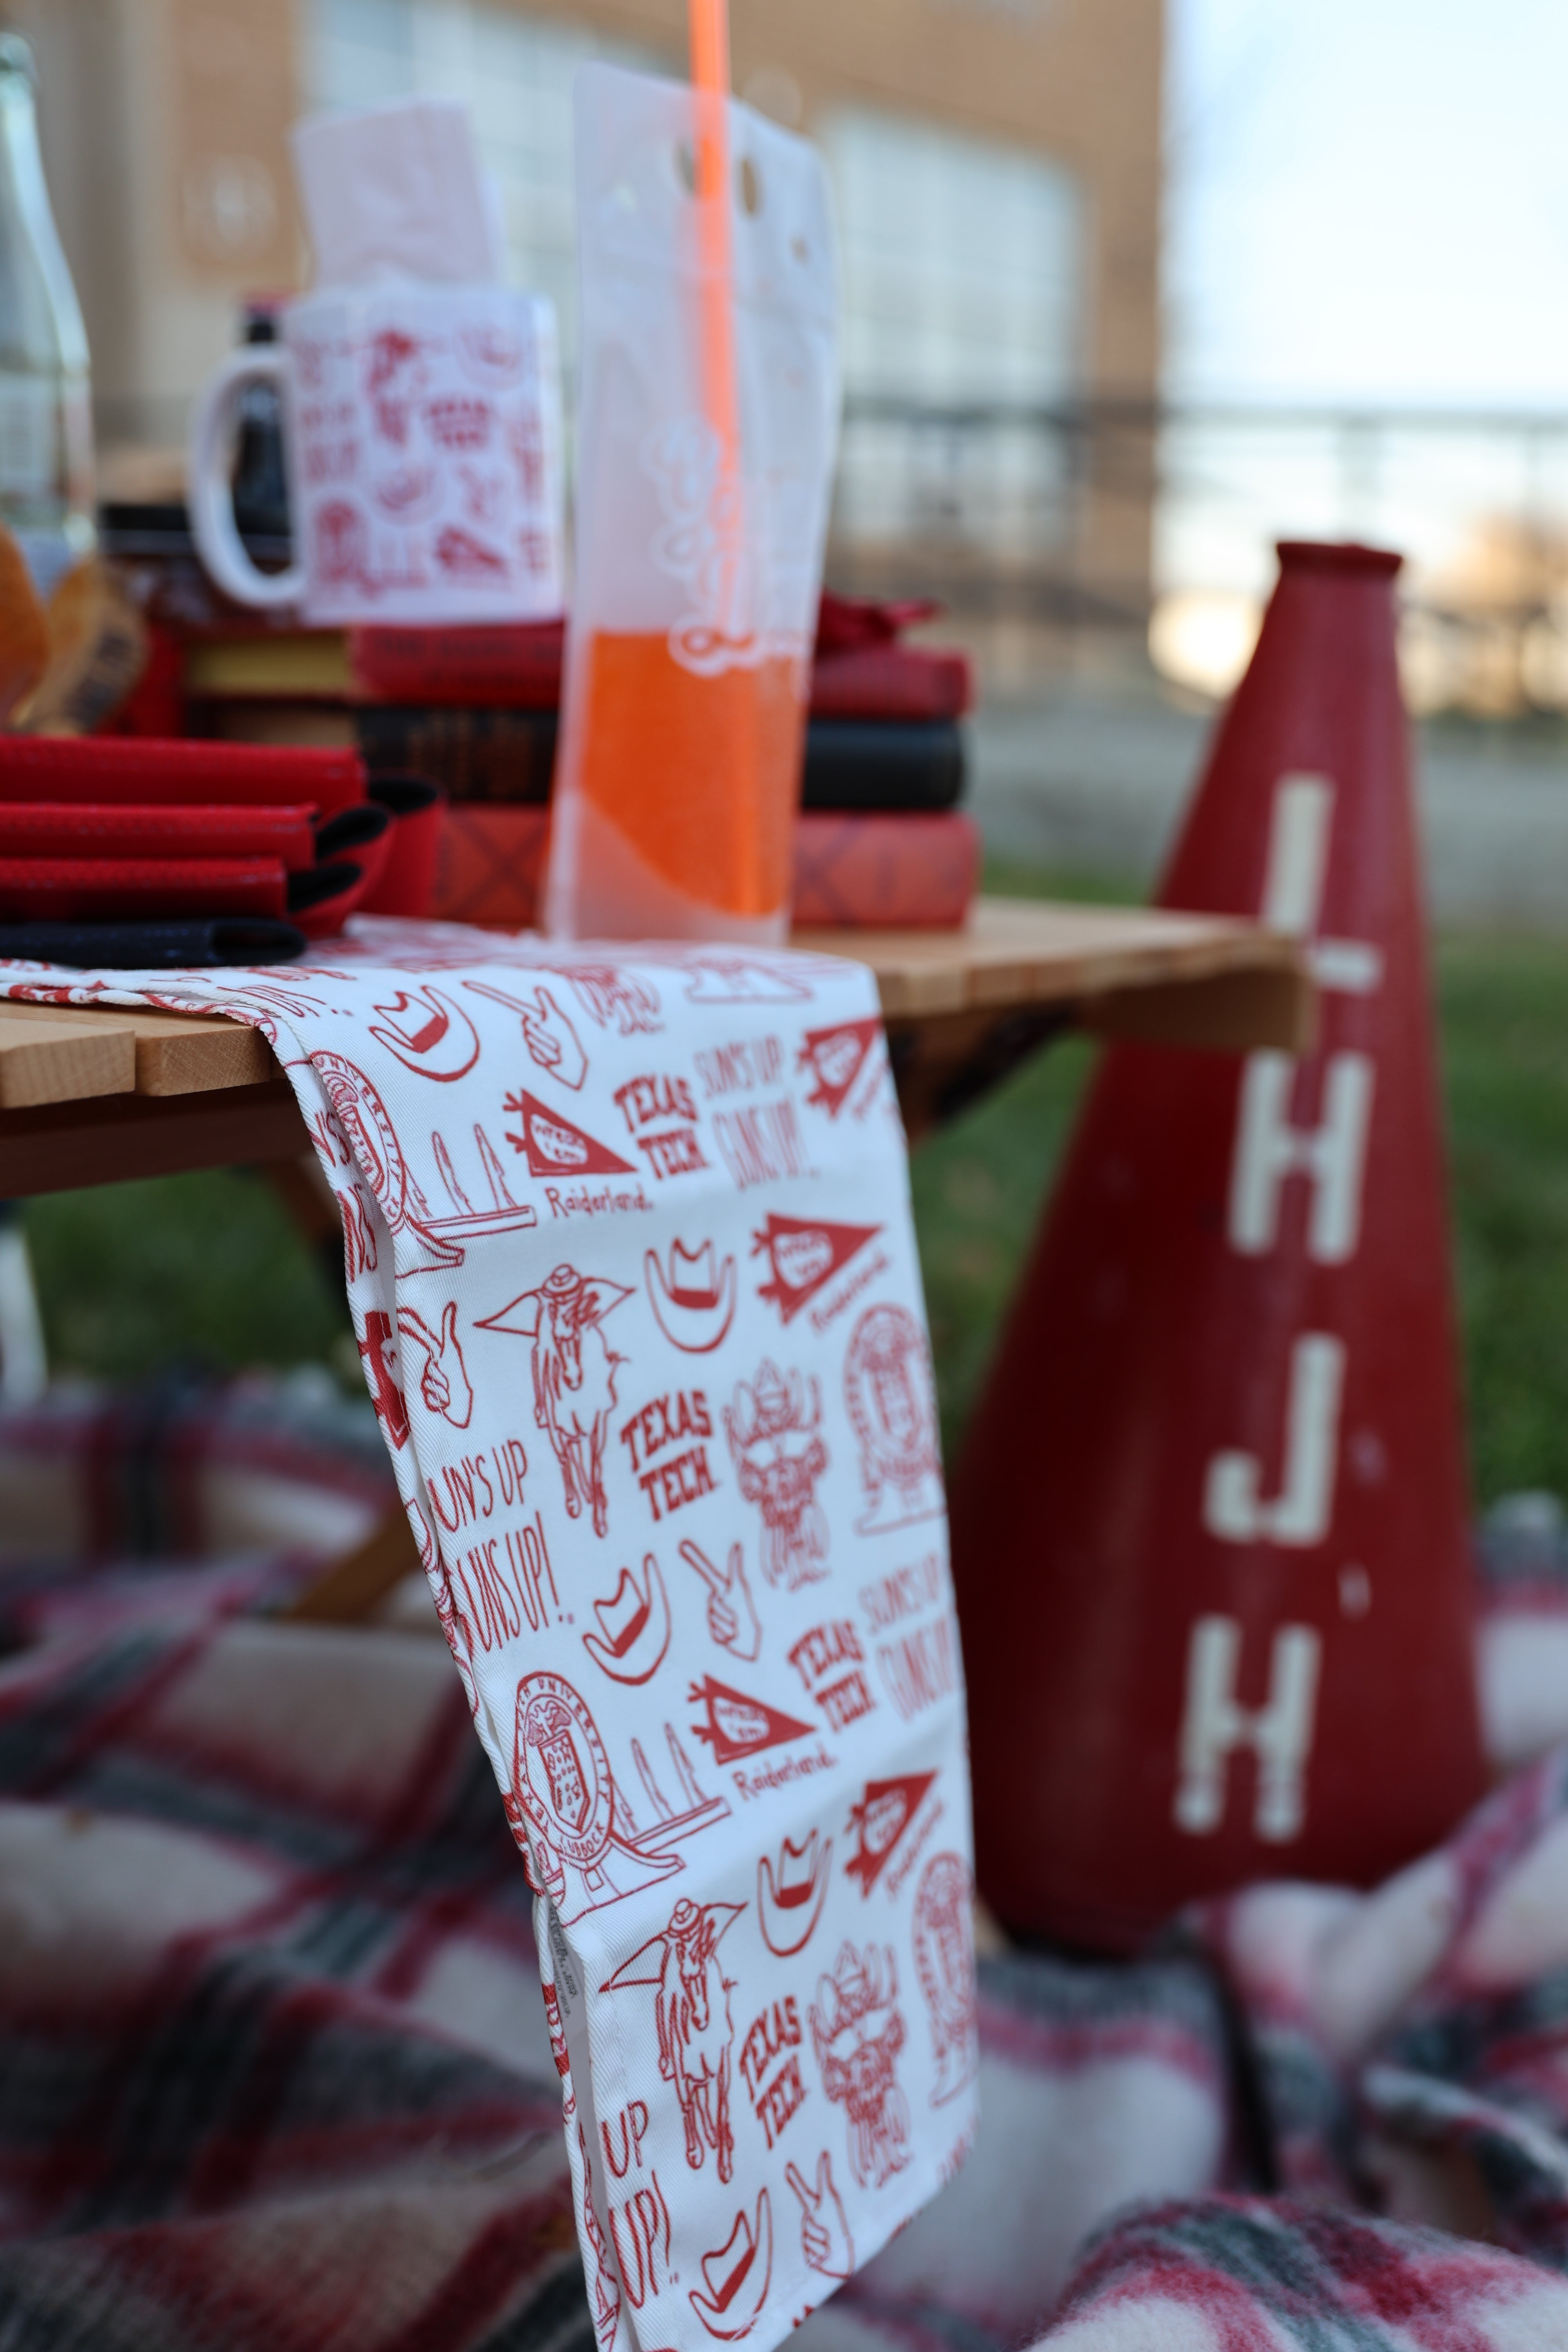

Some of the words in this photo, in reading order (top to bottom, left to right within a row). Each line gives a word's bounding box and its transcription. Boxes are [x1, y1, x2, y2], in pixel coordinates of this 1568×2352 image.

[613, 1072, 698, 1134] TEXAS
[637, 1129, 708, 1180] TECH
[621, 1390, 711, 1473] TEXAS
[426, 1454, 493, 1533] UN'S
[492, 1439, 528, 1504] UP
[640, 1445, 714, 1521] TECH
[788, 1621, 864, 1690] TEXAS
[740, 1995, 801, 2103] TEXAS
[601, 2100, 649, 2178] UP
[756, 2054, 806, 2150] TECH
